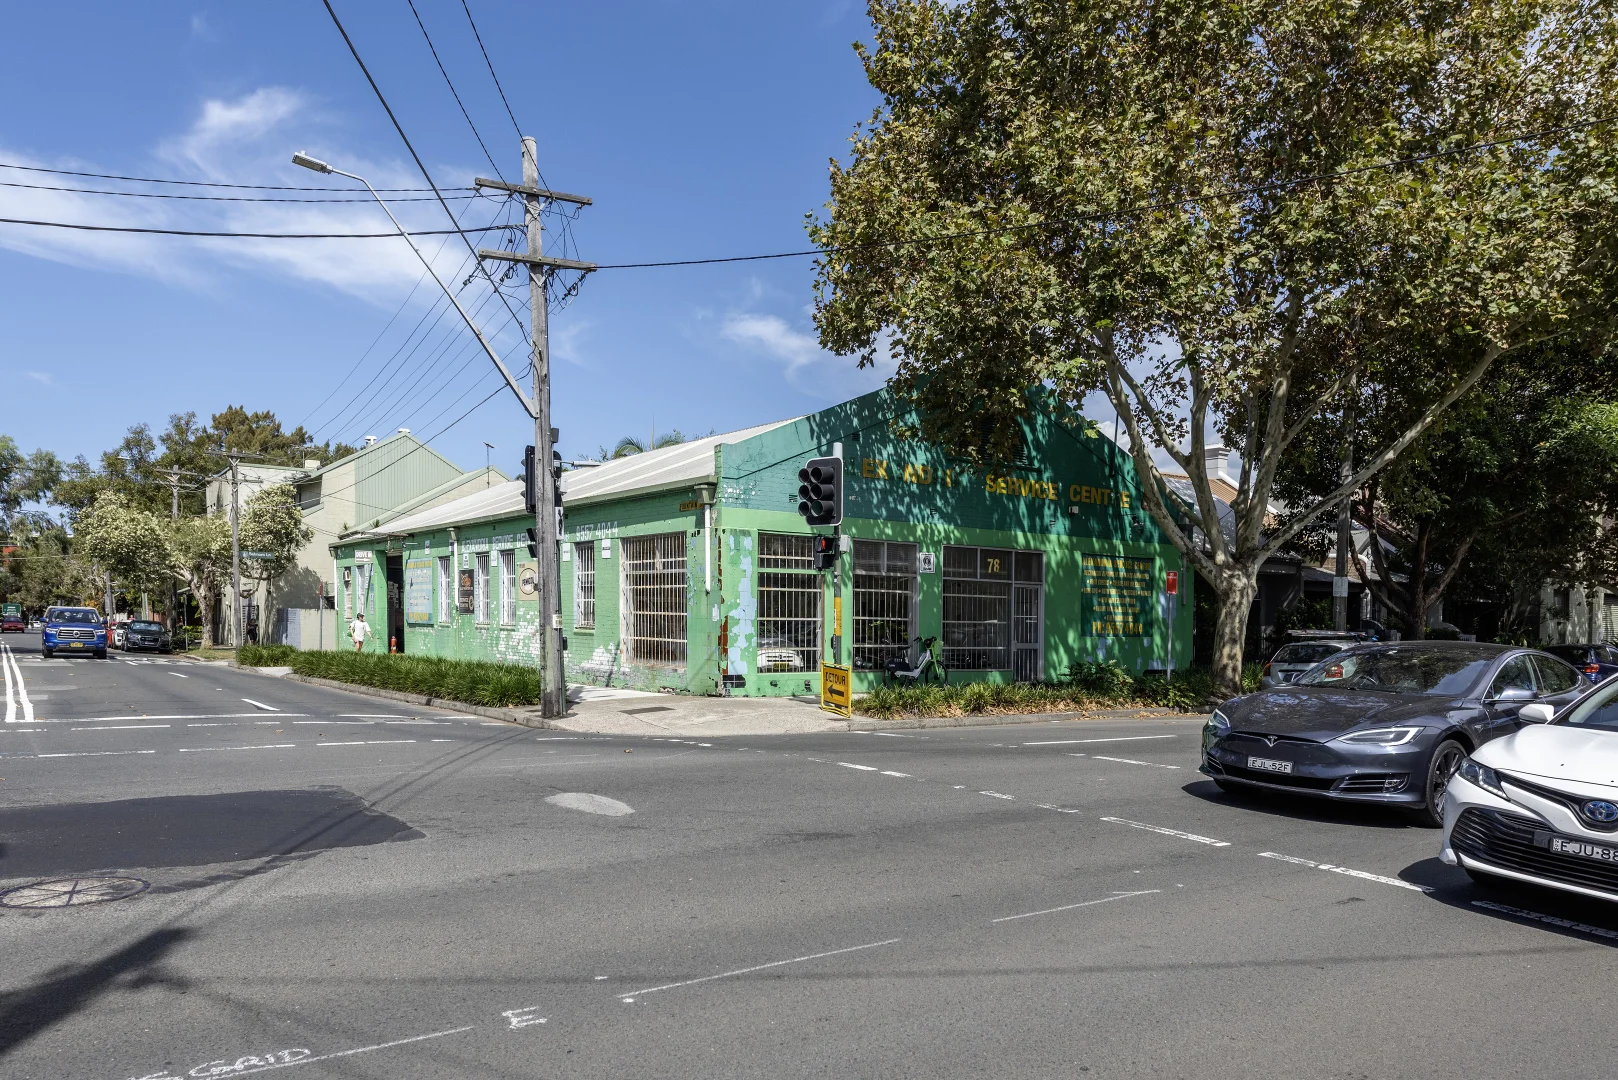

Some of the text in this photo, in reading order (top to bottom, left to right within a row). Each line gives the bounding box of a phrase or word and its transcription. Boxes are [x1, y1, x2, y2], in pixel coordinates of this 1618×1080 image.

[985, 474, 1058, 500] SERVICE
[1069, 484, 1130, 508] CENTE
[576, 523, 594, 541] 9557
[595, 521, 618, 539] 4044
[987, 558, 1000, 573] 78
[1125, 622, 1143, 635] 4044
[825, 671, 846, 686] DETOUR
